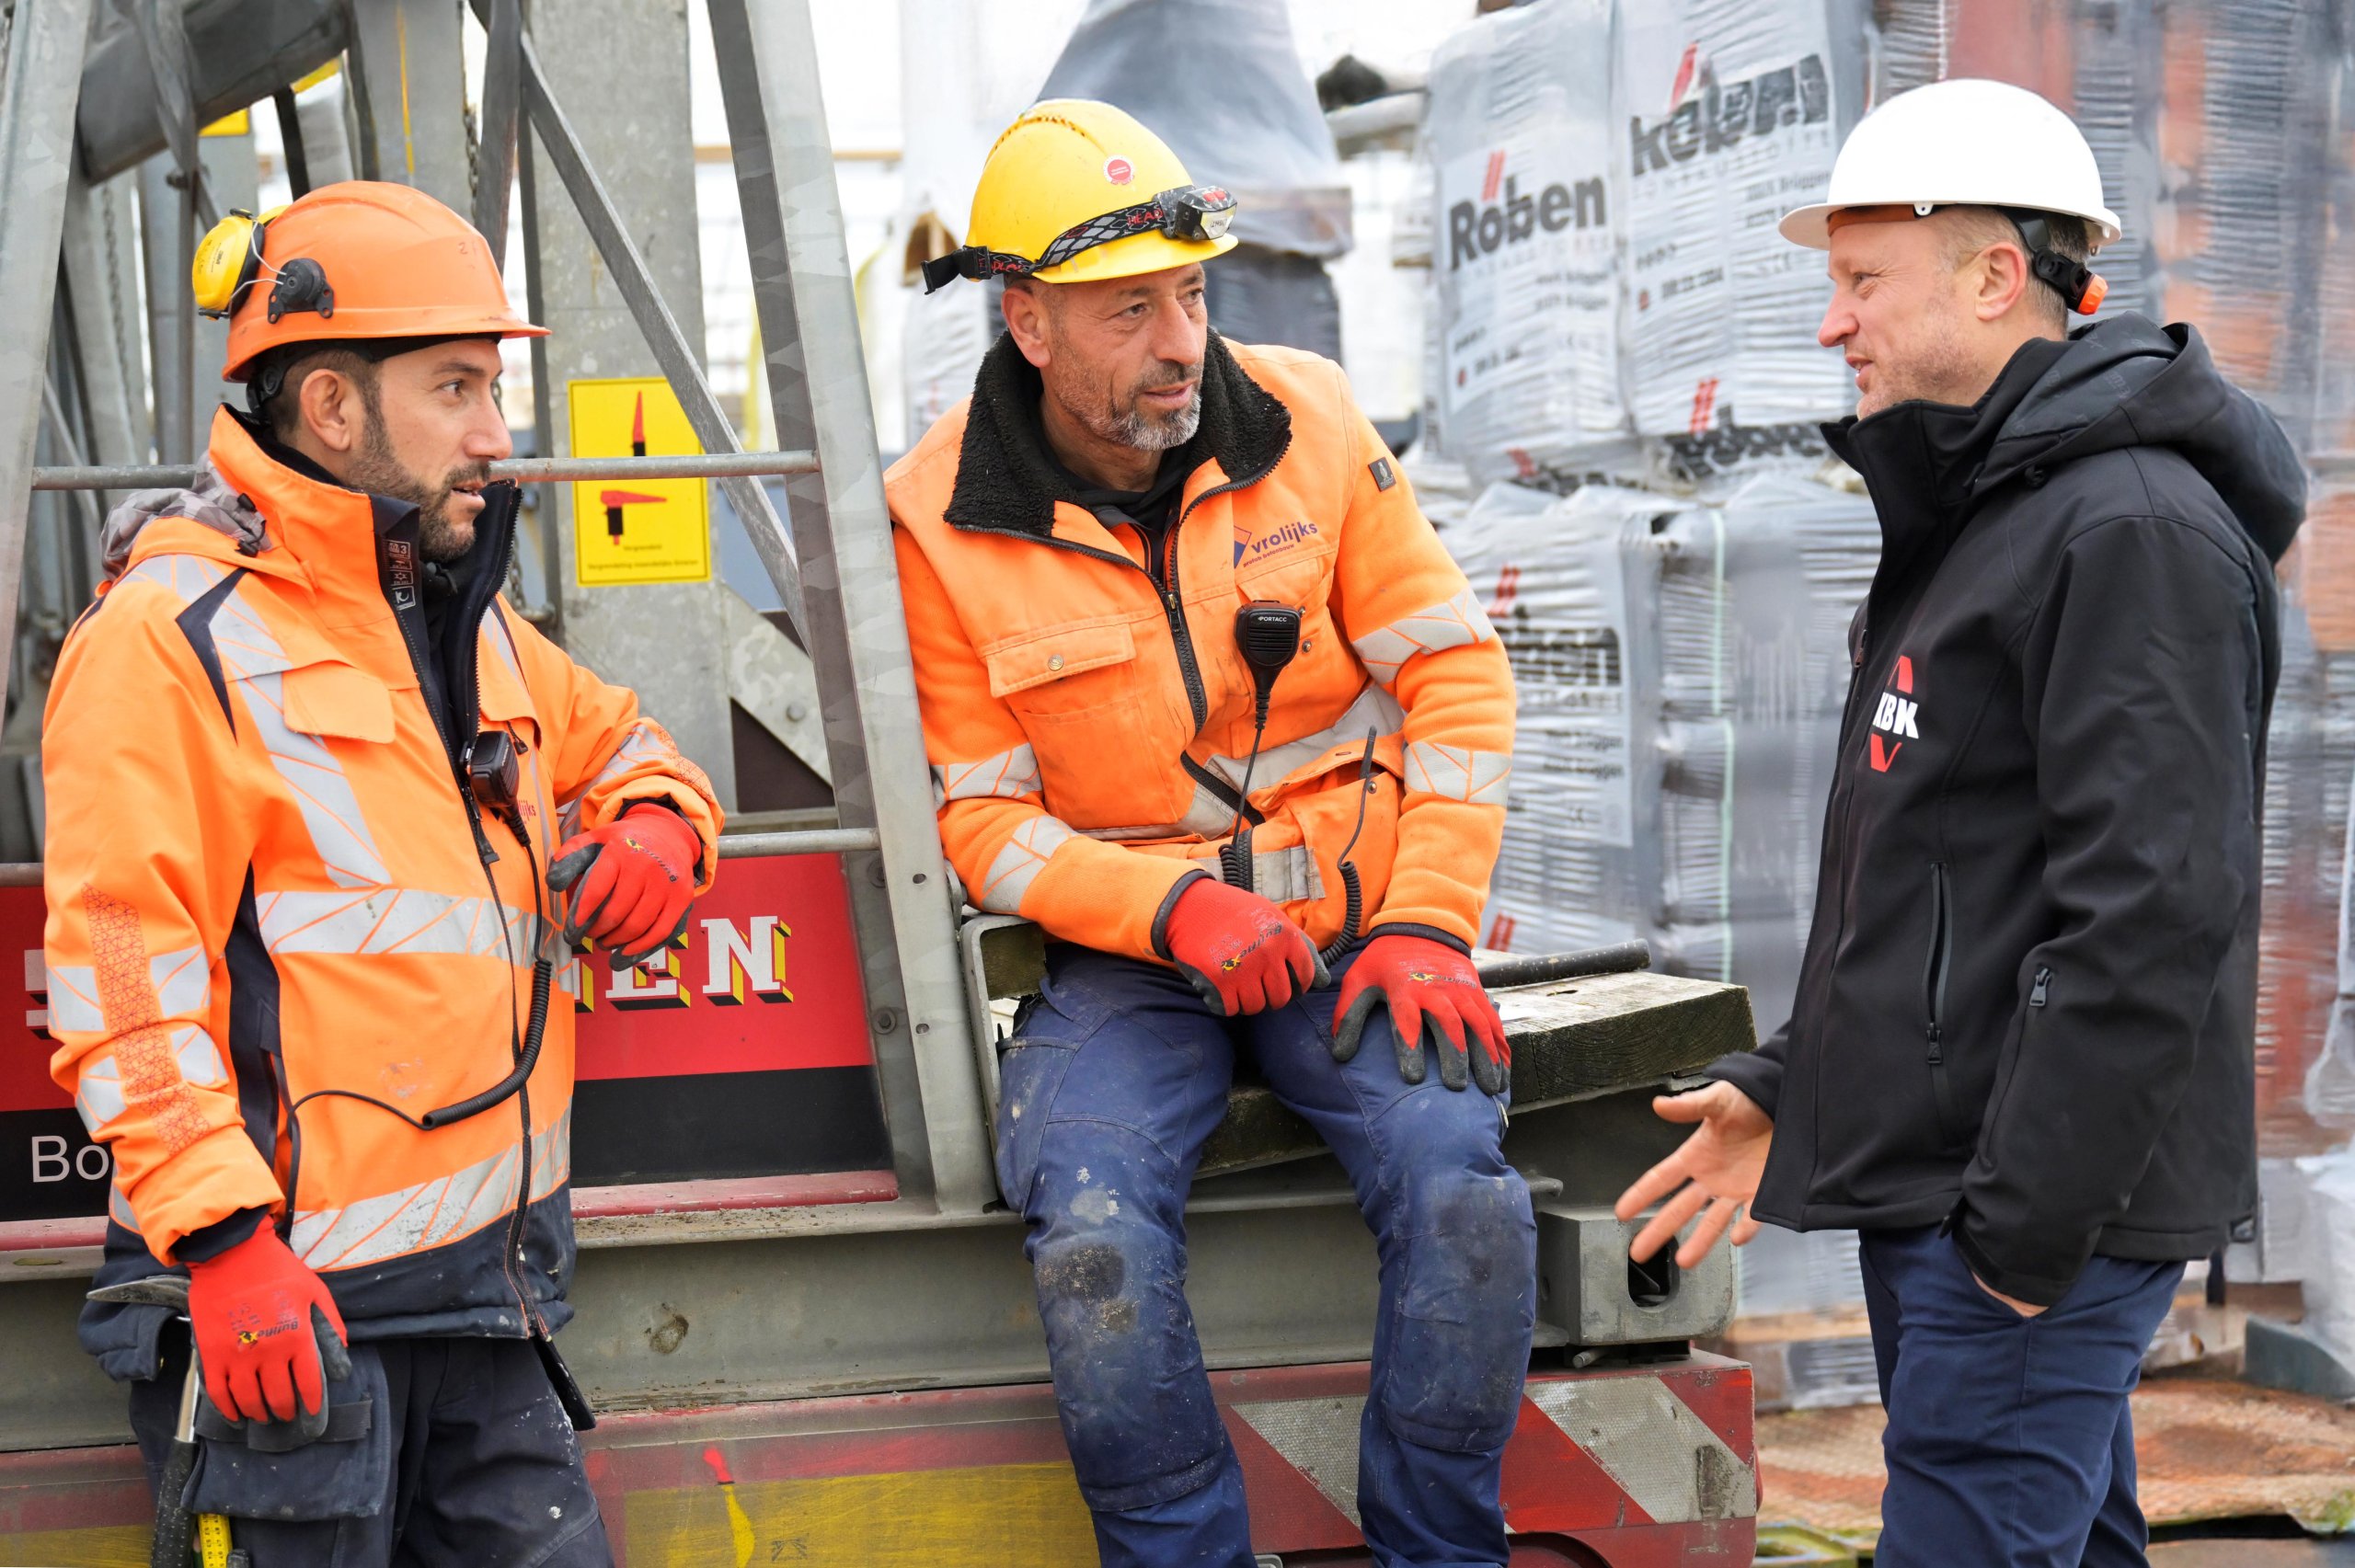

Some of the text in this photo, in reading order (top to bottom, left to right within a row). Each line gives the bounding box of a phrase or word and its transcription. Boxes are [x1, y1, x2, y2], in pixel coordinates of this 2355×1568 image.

[1450, 148, 1607, 273] Röben
[1251, 521, 1318, 554] vrolijks
[1872, 692, 1920, 739] KBK
[572, 915, 781, 1000] EN
[31, 1135, 109, 1184] Bo
